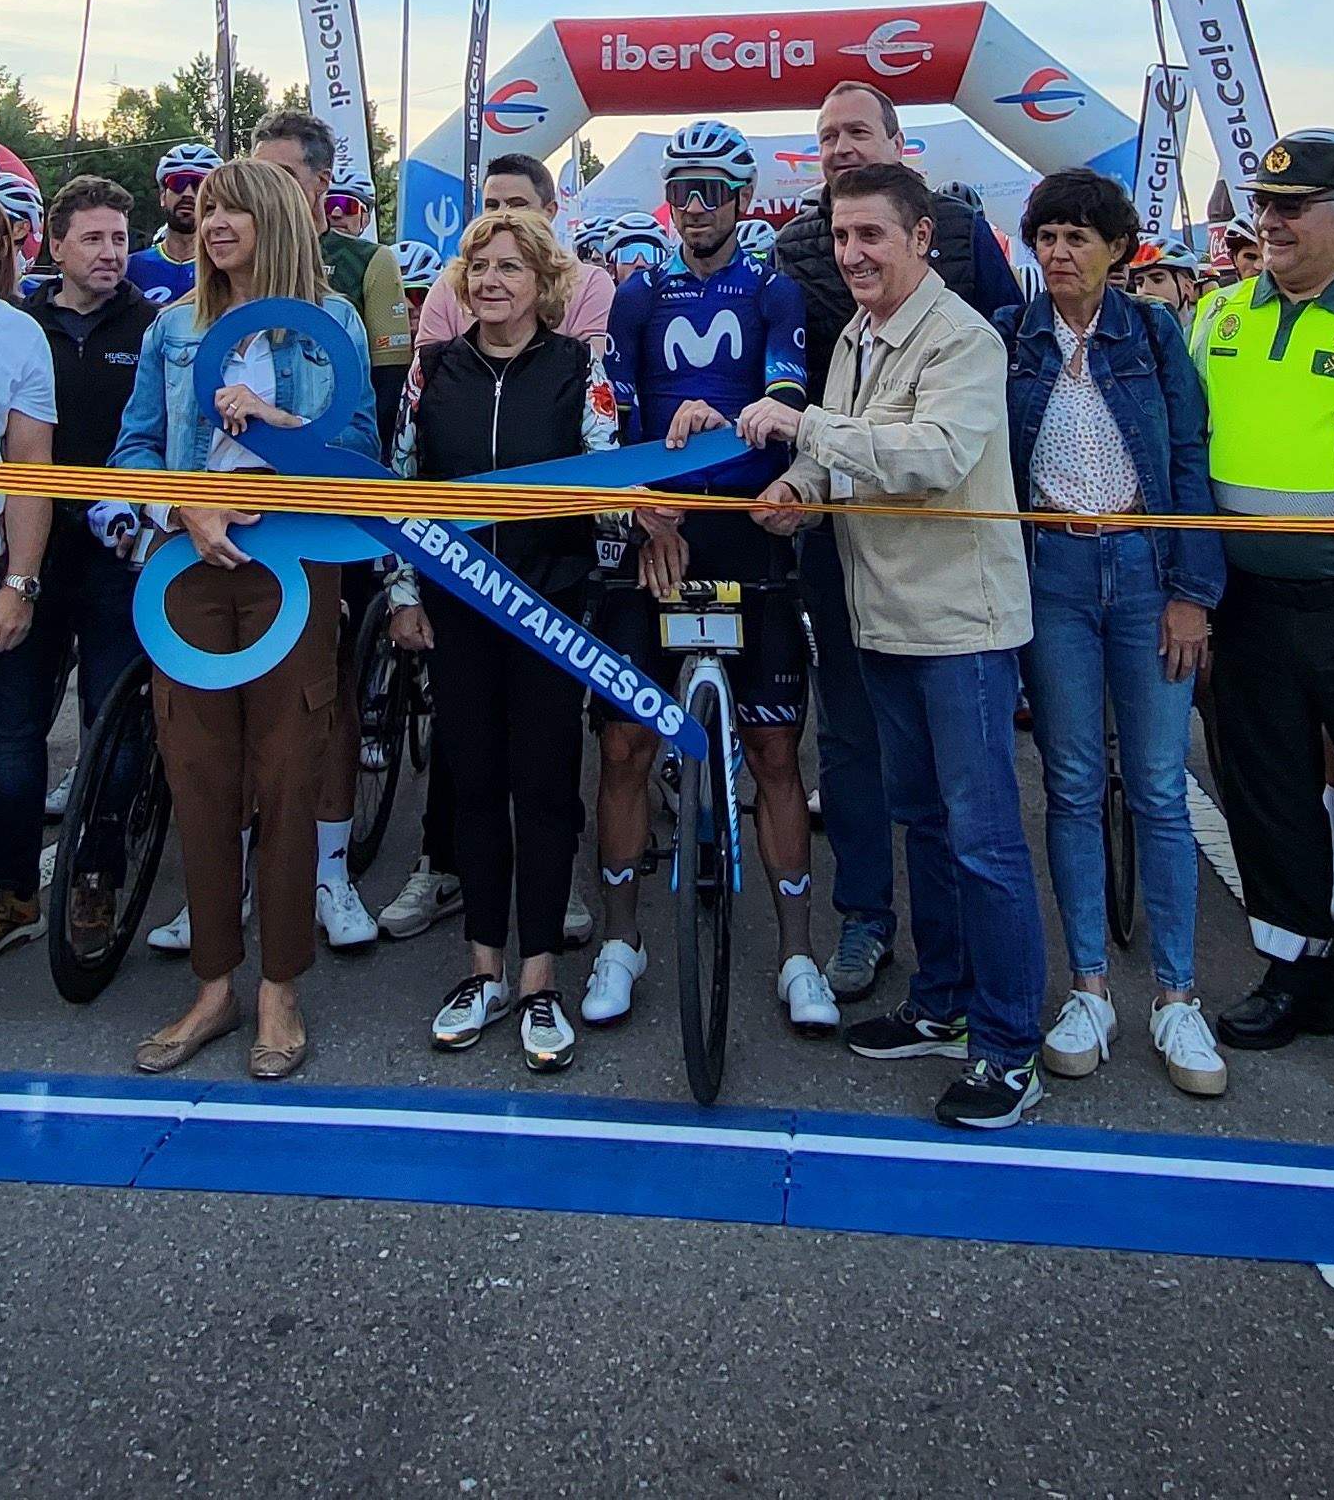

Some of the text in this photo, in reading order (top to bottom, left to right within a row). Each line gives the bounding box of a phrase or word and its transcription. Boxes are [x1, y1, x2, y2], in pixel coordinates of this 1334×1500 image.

[601, 29, 815, 79] iberCaja
[601, 542, 622, 562] 90
[385, 516, 685, 736] EBRANTAHUESOS
[696, 616, 707, 637] 1
